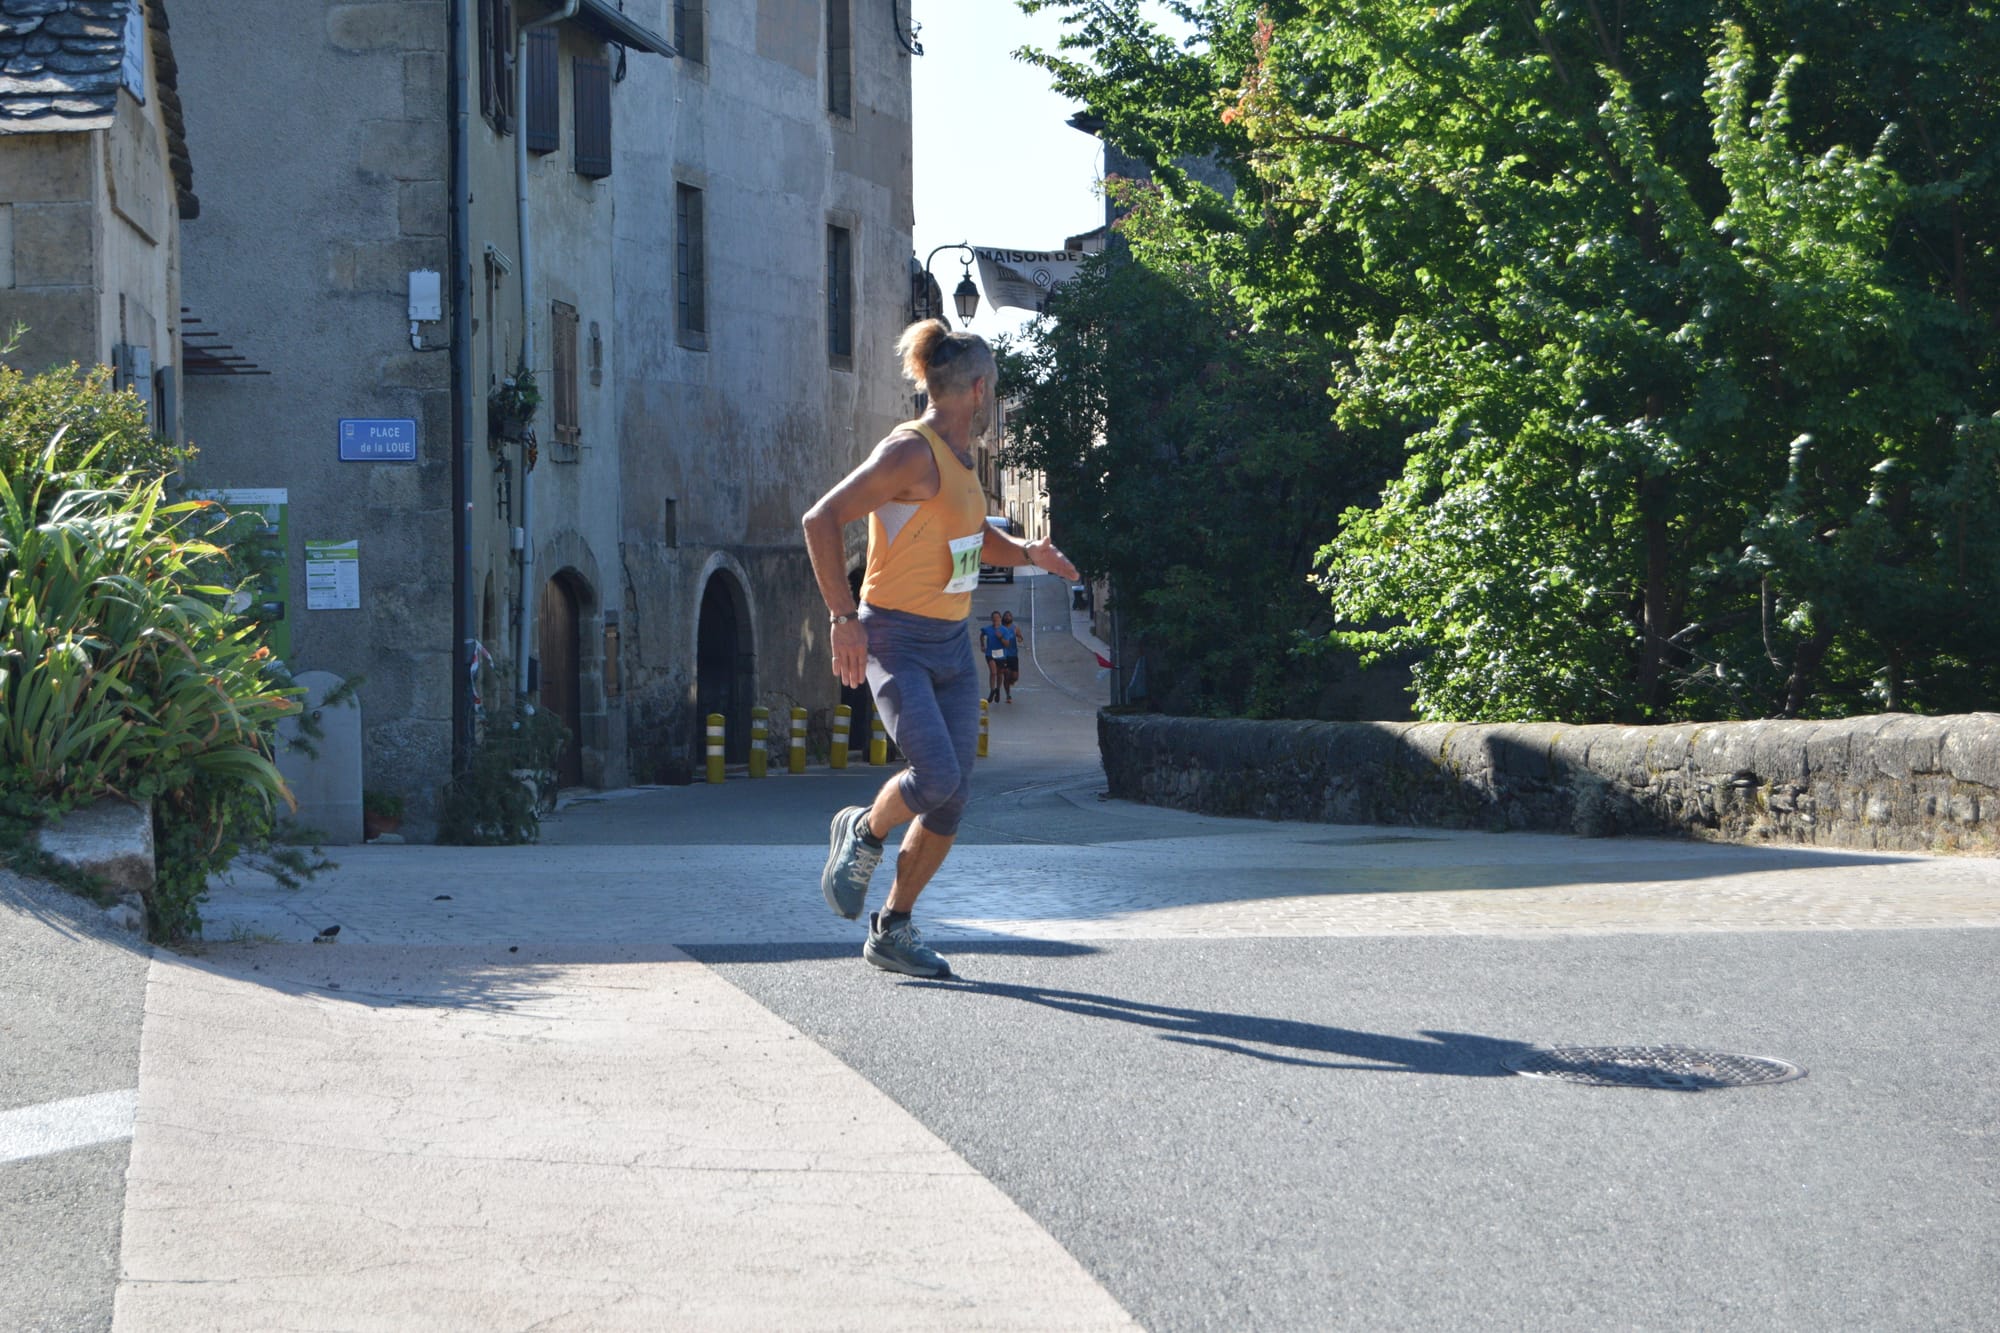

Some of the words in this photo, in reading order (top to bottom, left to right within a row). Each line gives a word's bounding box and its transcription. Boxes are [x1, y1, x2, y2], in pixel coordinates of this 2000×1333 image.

[980, 250, 1049, 263] MAISON
[1055, 252, 1078, 262] DE
[370, 427, 400, 438] PLACE
[360, 442, 371, 453] de
[374, 442, 383, 453] la
[386, 442, 411, 453] LOUE
